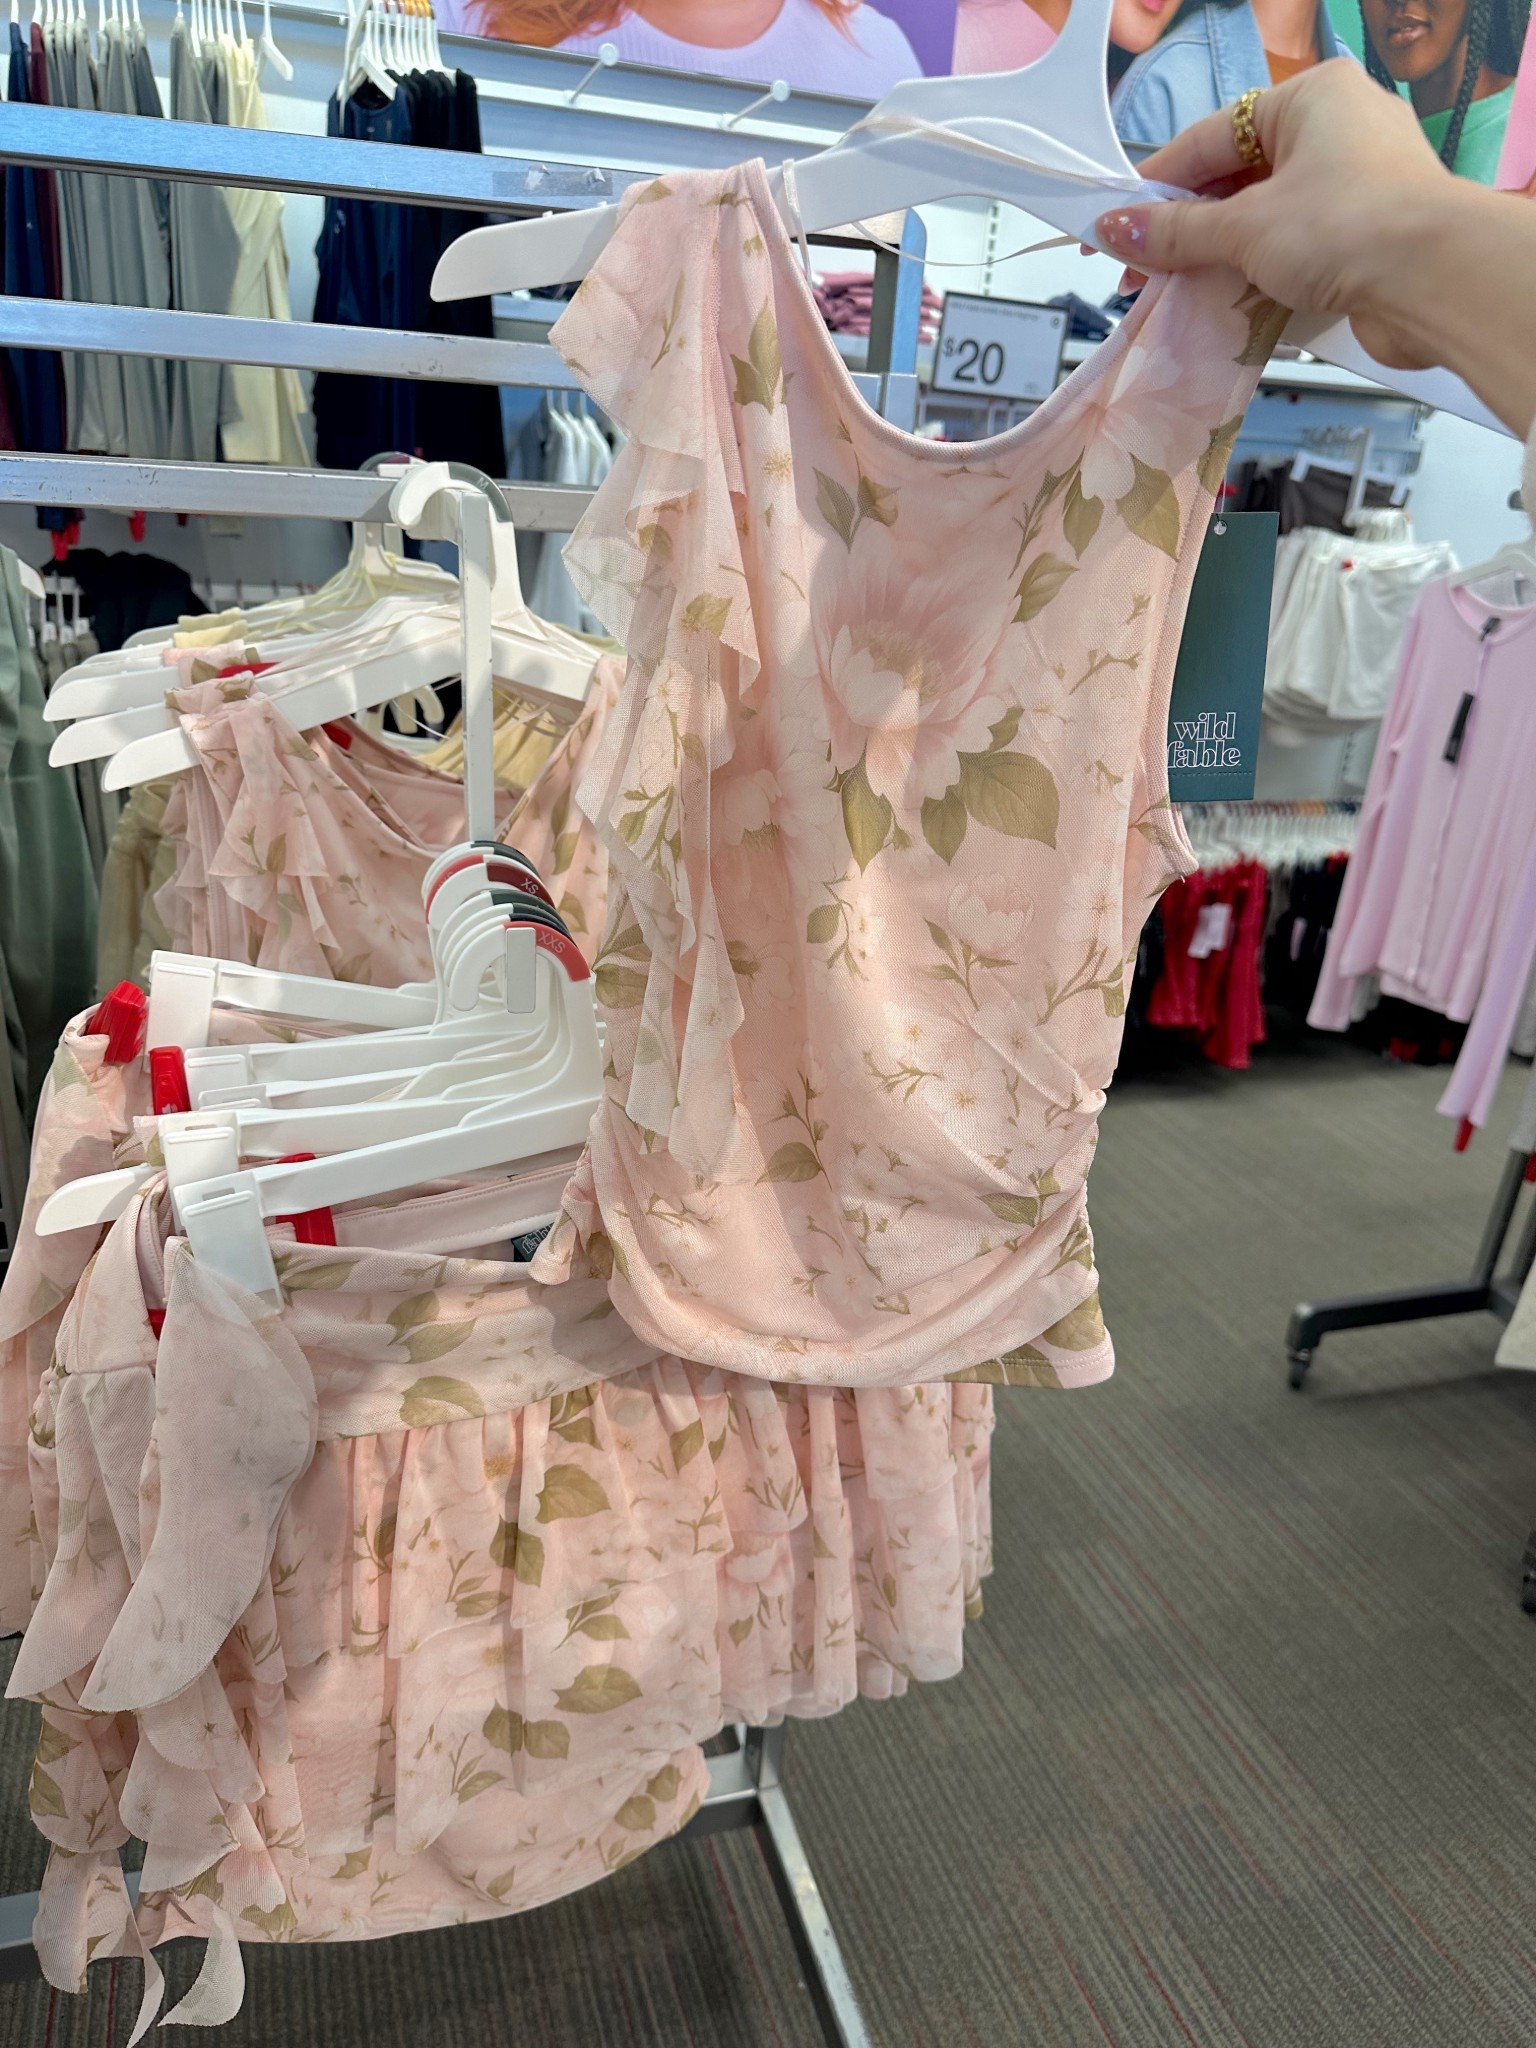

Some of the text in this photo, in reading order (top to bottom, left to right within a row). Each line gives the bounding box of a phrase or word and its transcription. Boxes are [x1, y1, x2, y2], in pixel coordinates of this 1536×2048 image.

[943, 338, 1004, 385] $20
[475, 476, 489, 490] M
[1173, 712, 1236, 740] wild
[521, 878, 539, 894] XS
[538, 931, 566, 953] XXS
